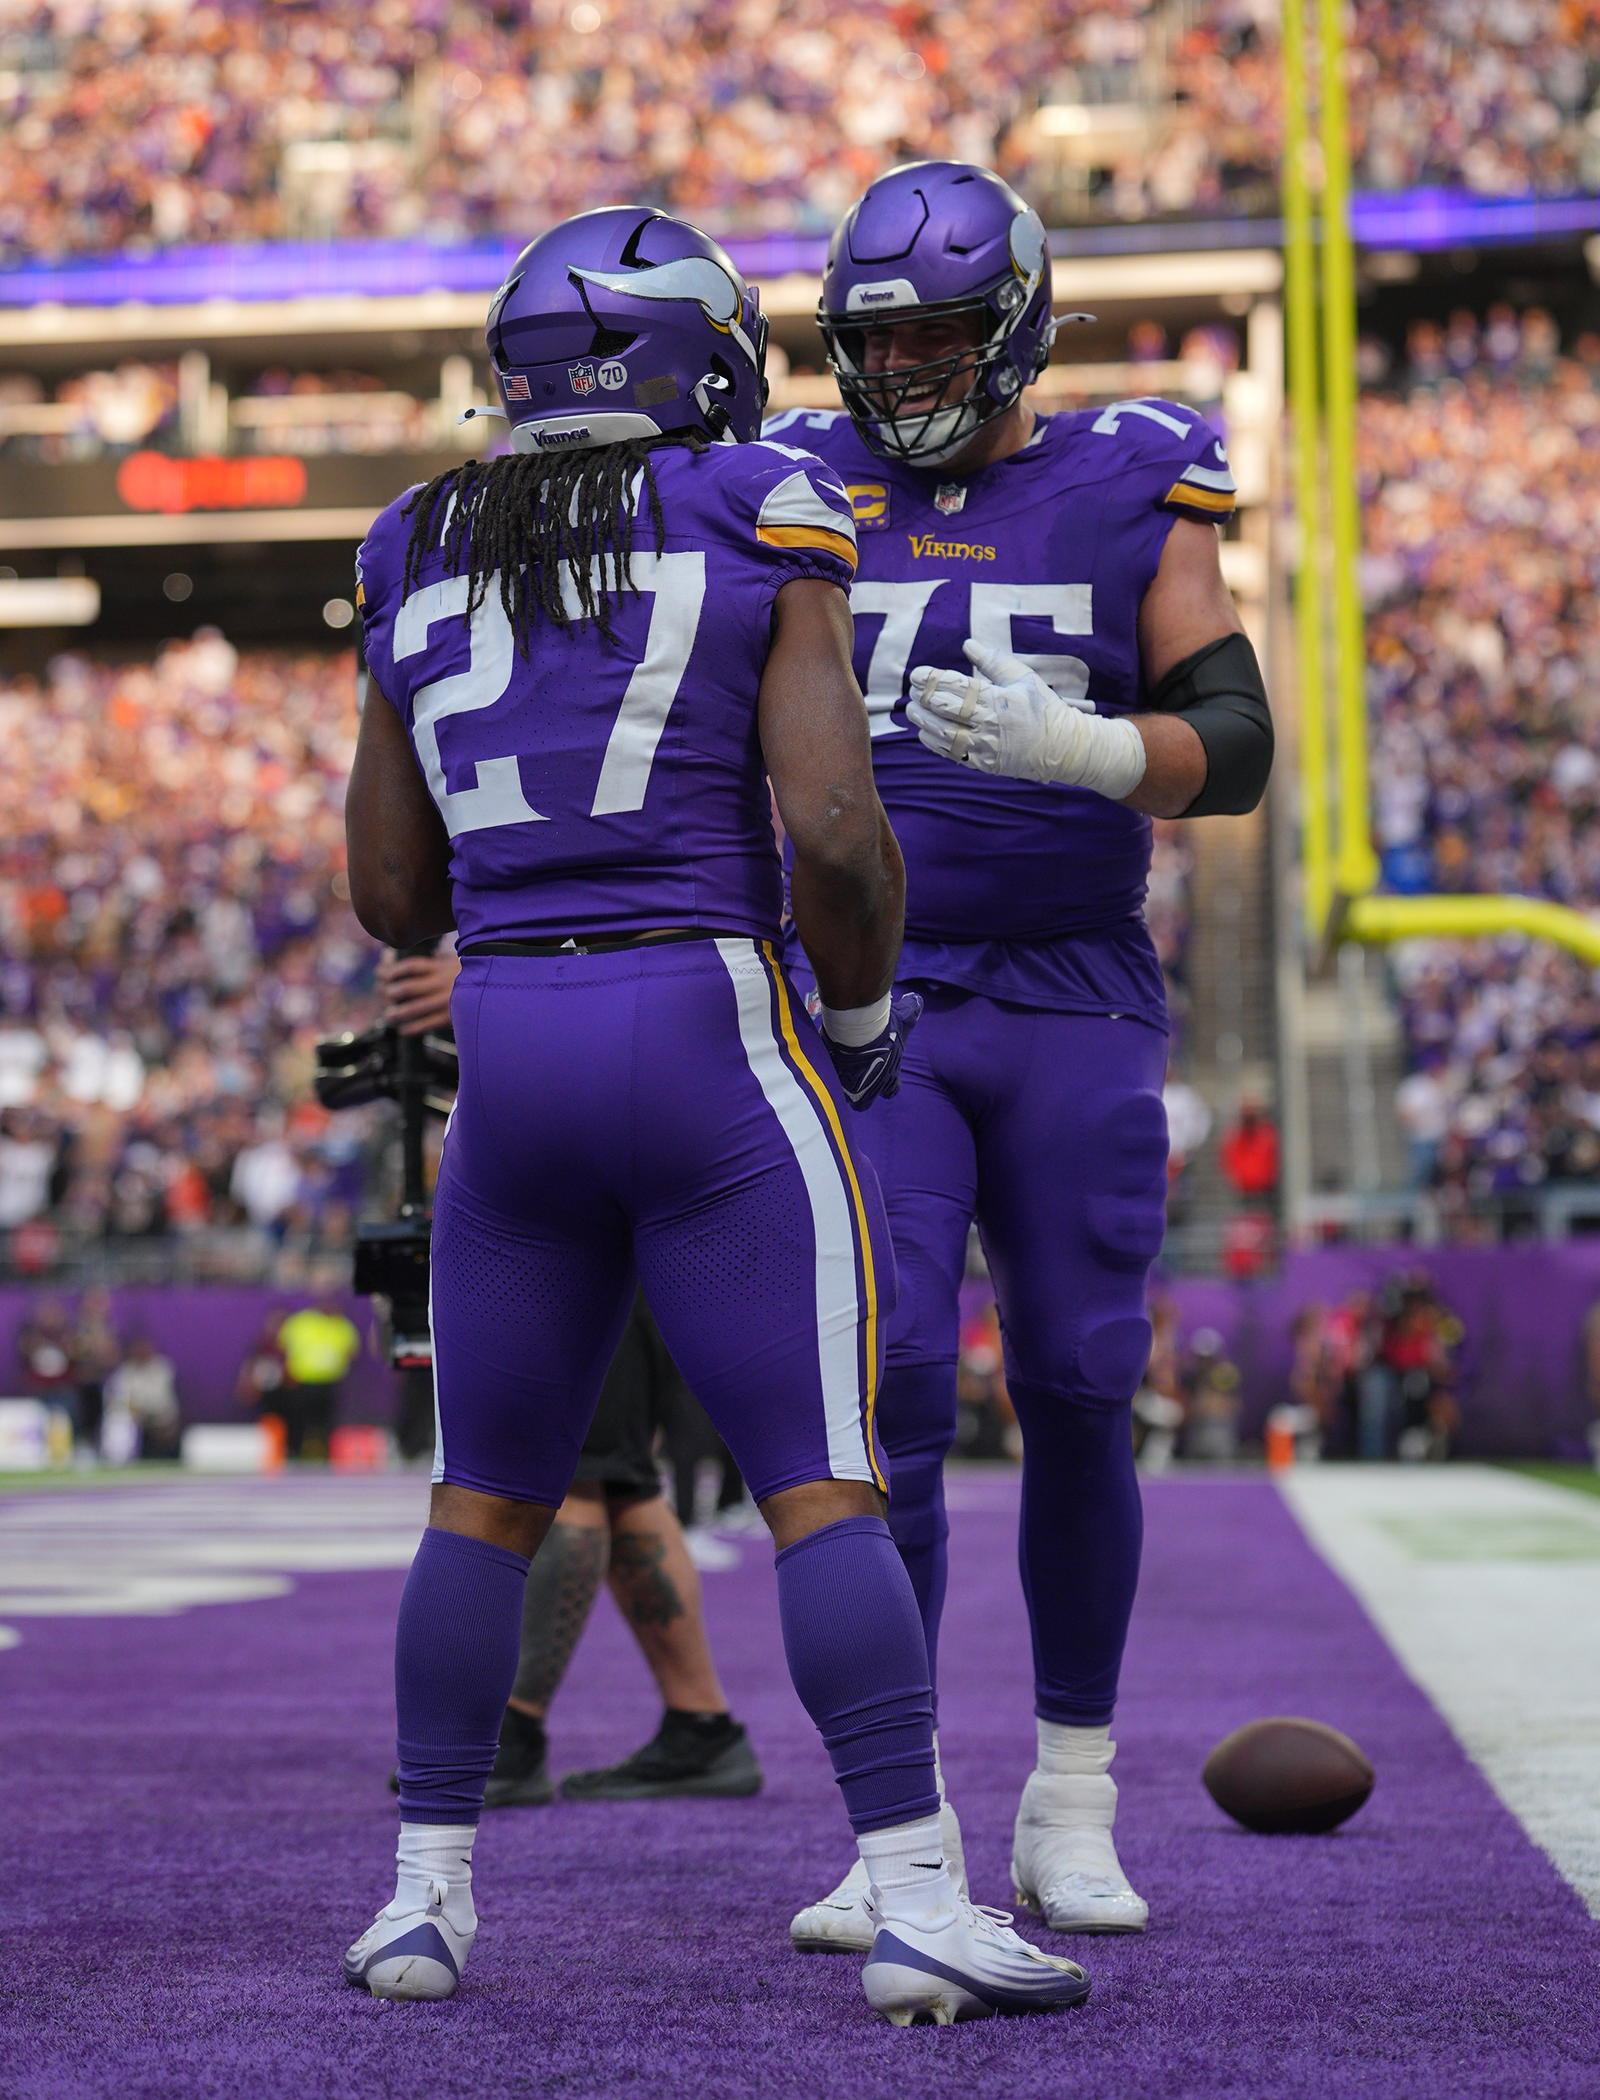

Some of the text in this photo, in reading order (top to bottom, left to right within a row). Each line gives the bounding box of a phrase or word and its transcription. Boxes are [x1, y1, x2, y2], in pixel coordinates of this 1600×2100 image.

[573, 374, 594, 391] NFL
[601, 365, 624, 386] 70
[1091, 397, 1201, 440] 7
[846, 484, 887, 519] C
[939, 495, 960, 508] NFL
[849, 578, 1094, 738] 75
[393, 551, 706, 839] 27
